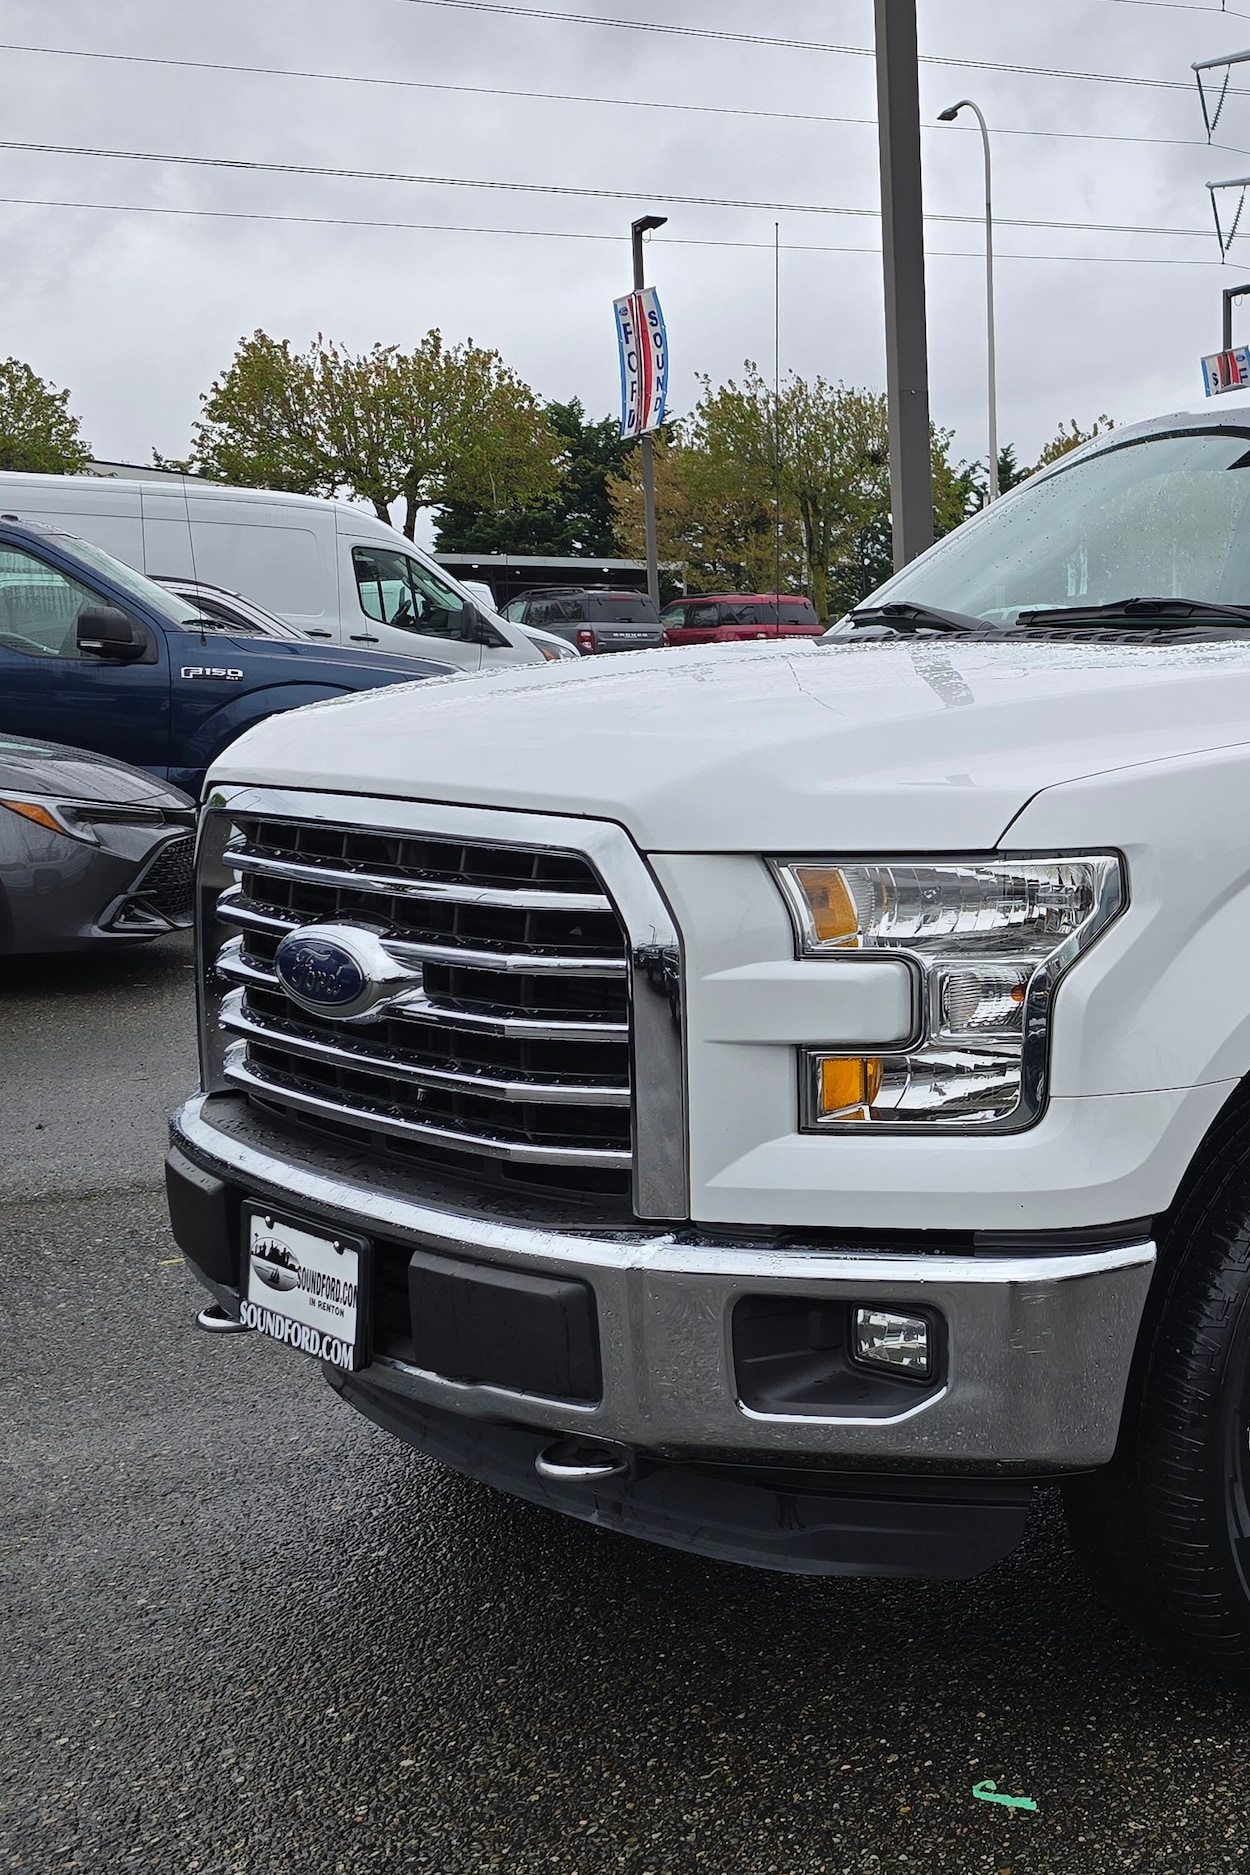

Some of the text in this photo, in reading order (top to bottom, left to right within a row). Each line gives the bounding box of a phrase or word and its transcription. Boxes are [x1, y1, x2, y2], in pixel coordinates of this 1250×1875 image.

[648, 310, 664, 413] SOUND
[292, 947, 344, 996] Ford
[239, 1300, 354, 1372] SOUNDFORD.COM
[308, 1296, 345, 1317] IN RENTON
